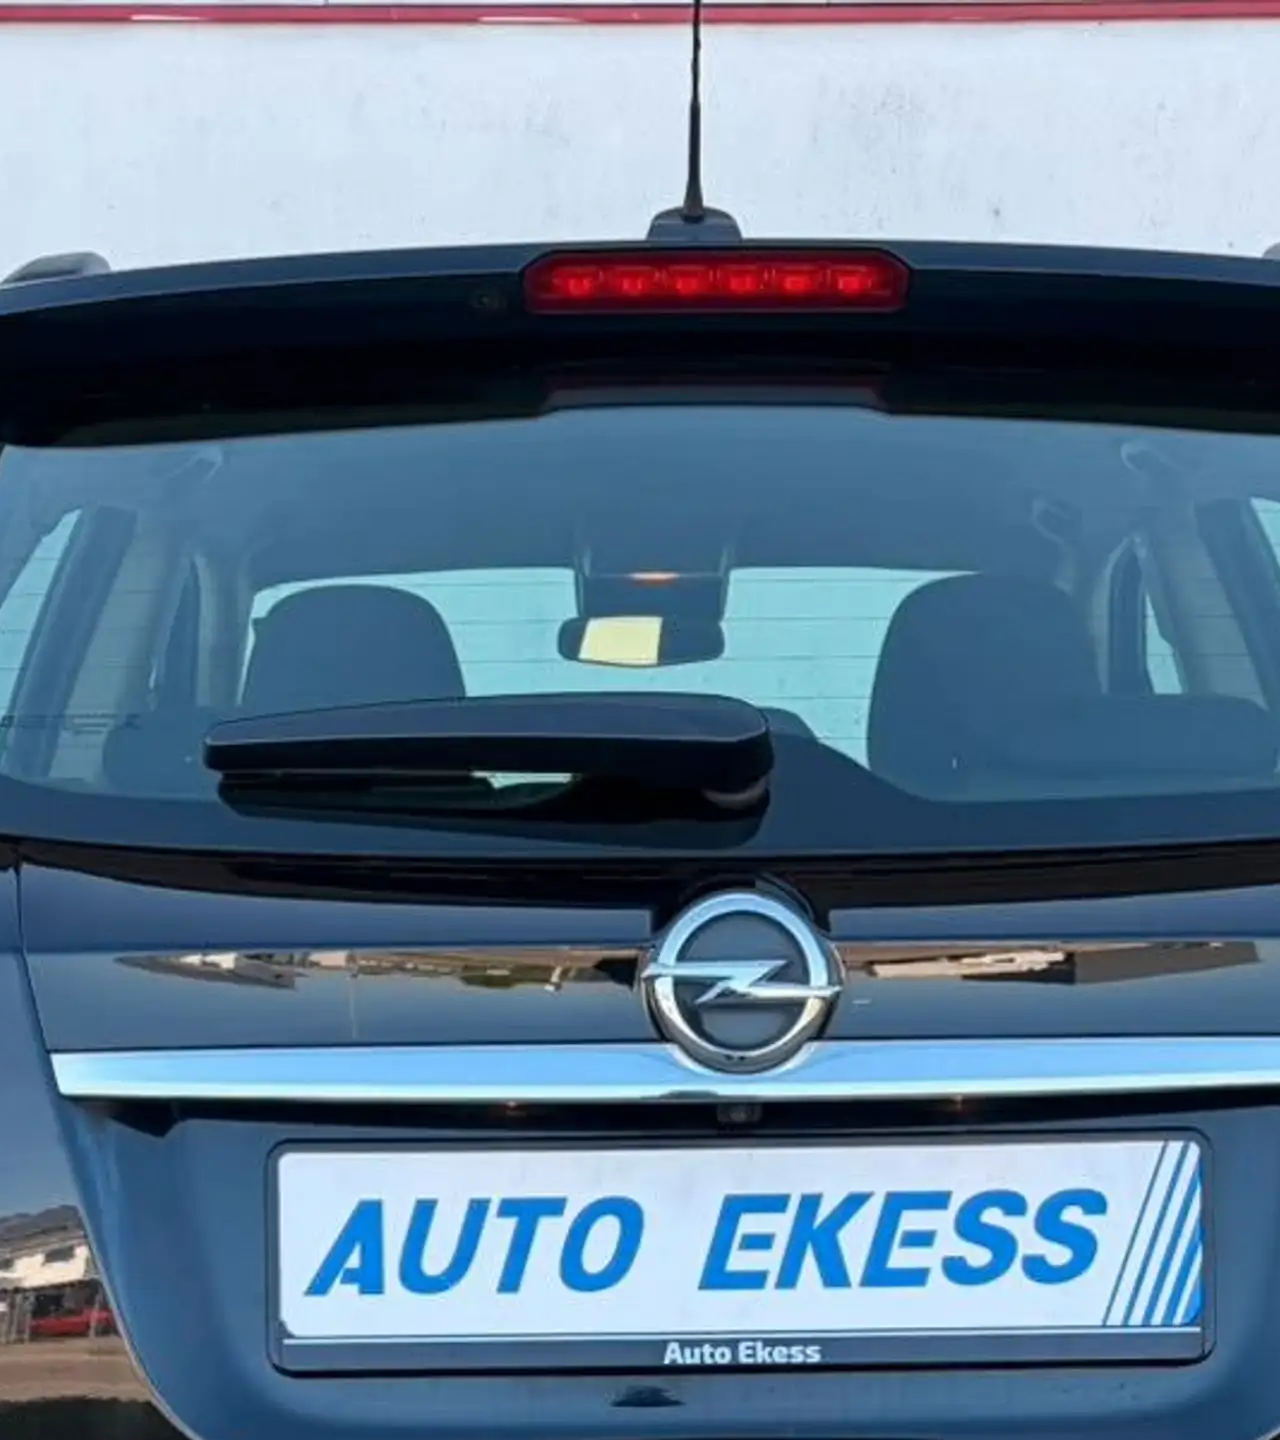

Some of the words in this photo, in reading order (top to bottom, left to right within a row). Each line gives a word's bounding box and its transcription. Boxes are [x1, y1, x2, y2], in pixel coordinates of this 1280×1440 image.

[305, 1198, 646, 1297] AUTO
[698, 1187, 1109, 1292] EKESS
[663, 1341, 731, 1364] Auto
[738, 1340, 821, 1363] Ekess
